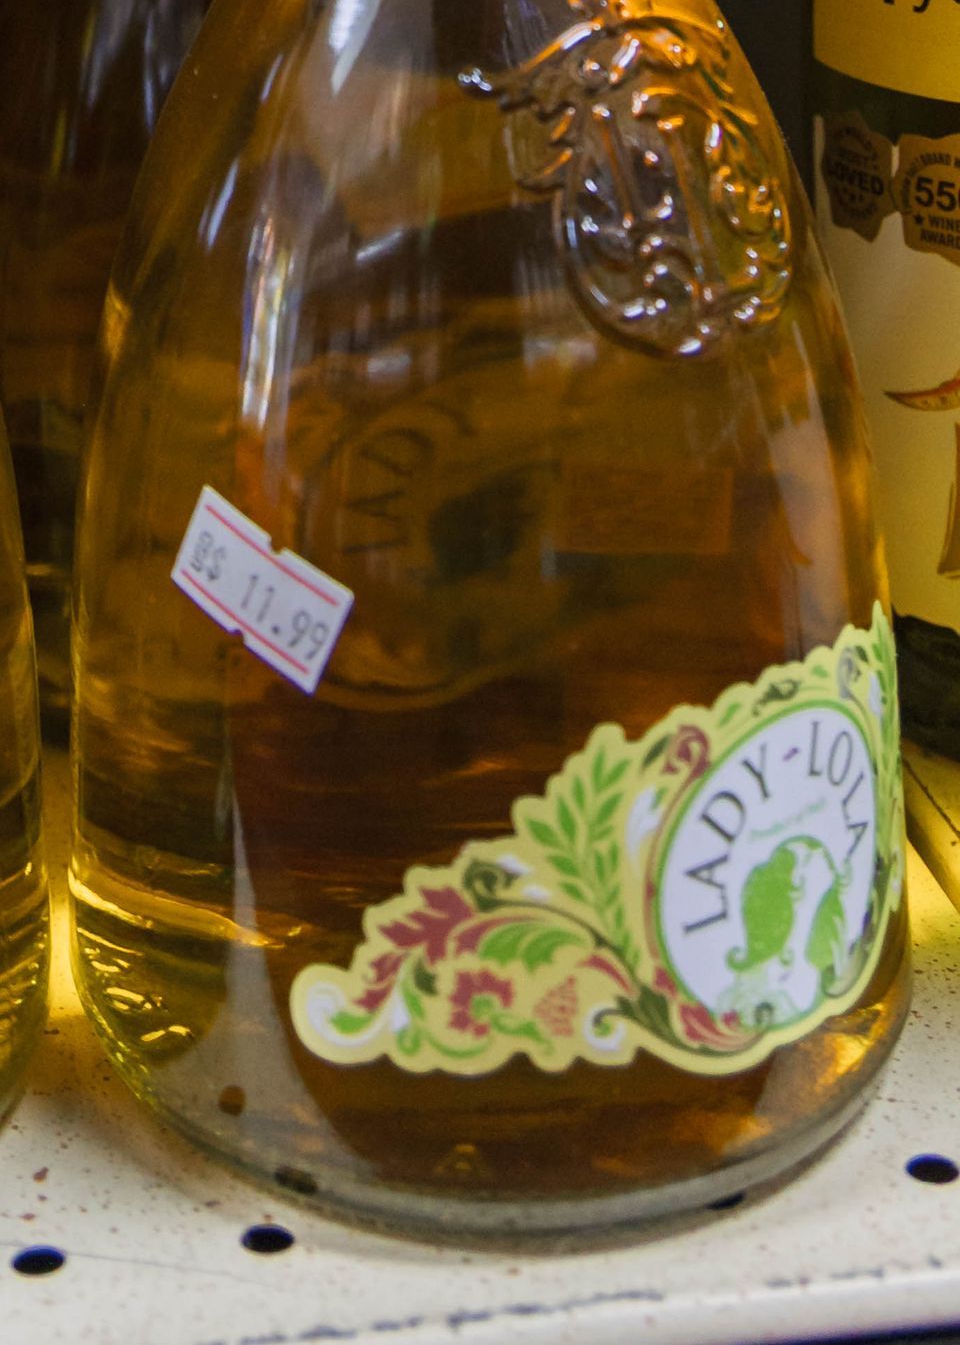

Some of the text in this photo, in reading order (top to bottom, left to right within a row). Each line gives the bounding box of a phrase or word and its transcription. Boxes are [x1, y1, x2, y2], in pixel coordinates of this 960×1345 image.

[241, 573, 331, 661] 11.99
[683, 720, 870, 938] LADY LOLA
